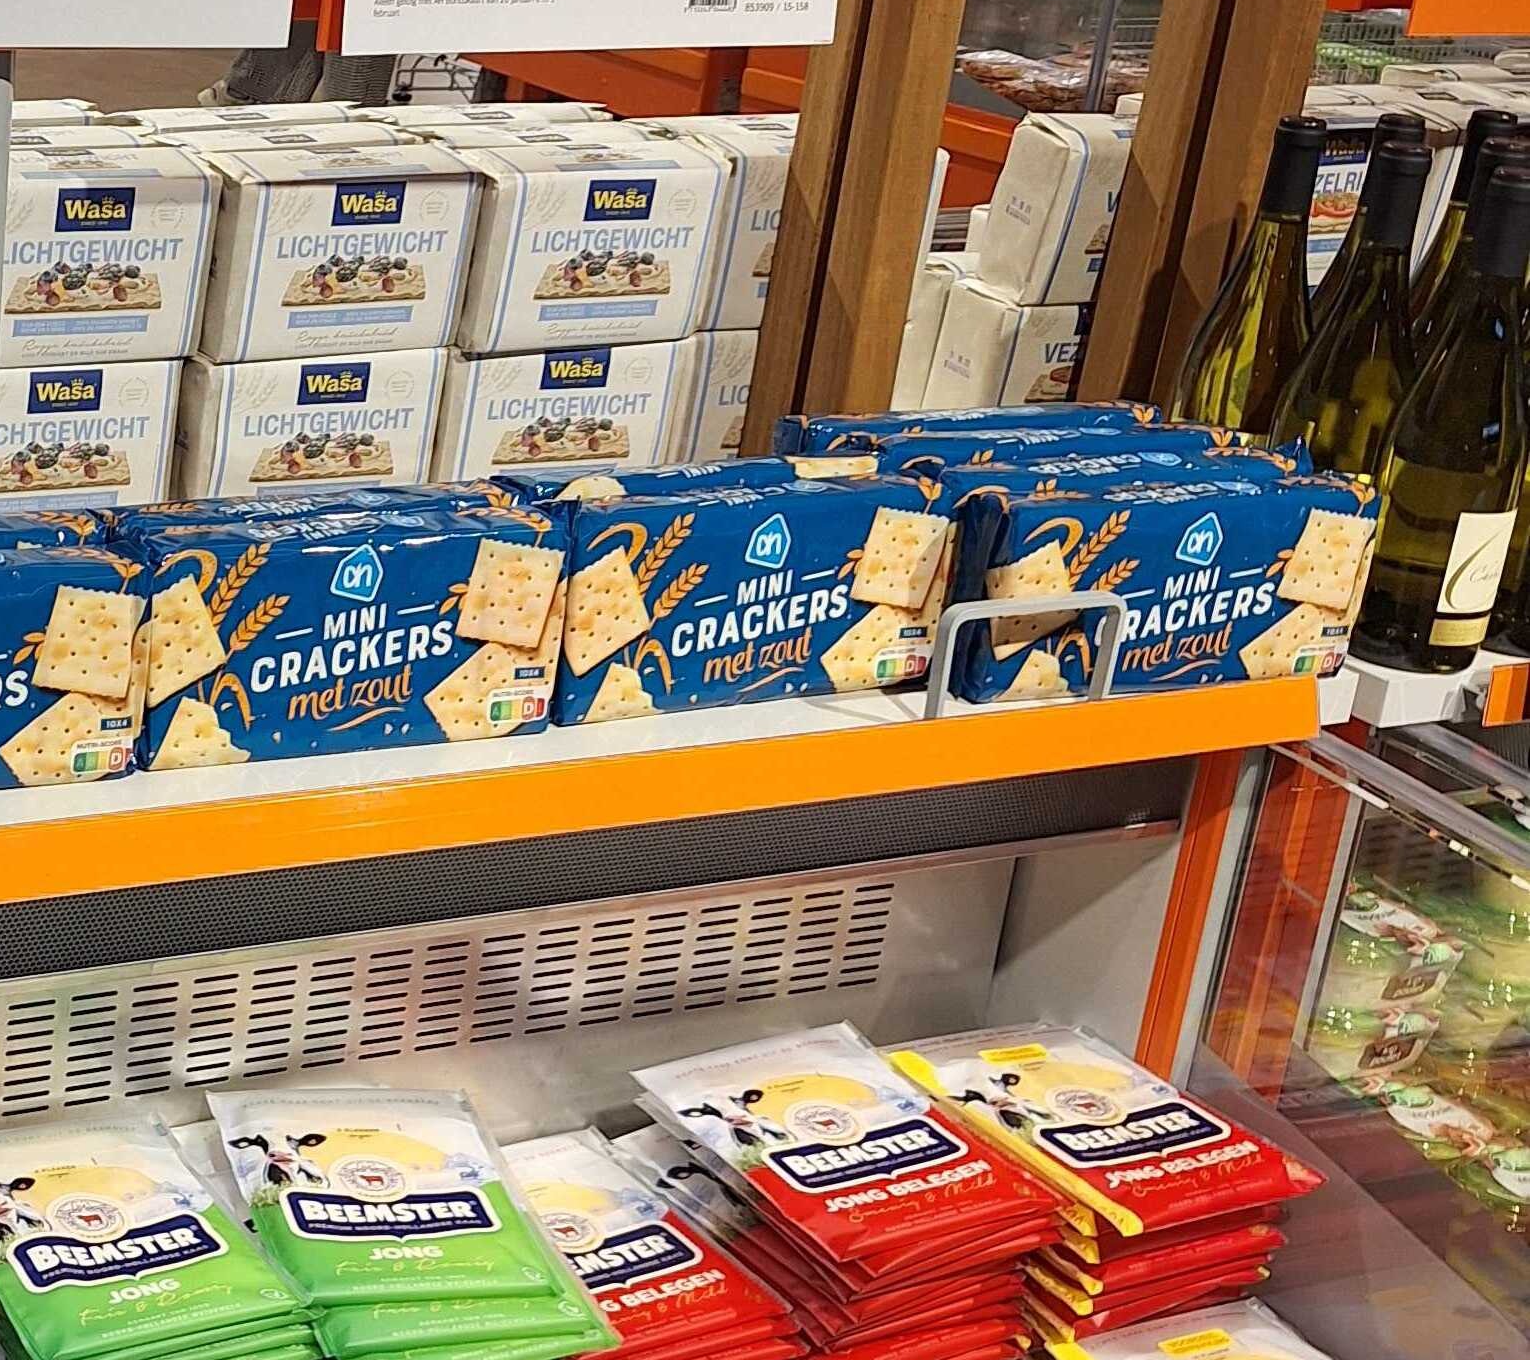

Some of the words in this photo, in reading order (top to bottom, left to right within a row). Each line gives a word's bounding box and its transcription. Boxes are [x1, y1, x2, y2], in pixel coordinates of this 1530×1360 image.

[530, 225, 693, 254] LICHTGEWICHT
[737, 571, 793, 601] MINI
[324, 602, 387, 640] MINI
[672, 583, 849, 657] CRACKERS
[251, 619, 453, 693] CRACKERS
[703, 645, 756, 684] met
[759, 629, 813, 670] zout
[288, 679, 345, 721] met
[351, 662, 413, 708] zout
[790, 1128, 938, 1179] BEEMSTER
[824, 1188, 884, 1215] JONG
[886, 1159, 990, 1199] BELEGEN
[301, 1198, 476, 1229] BEEMSTER
[28, 1227, 200, 1272] BEEMSTER
[368, 1244, 444, 1263] JONG
[107, 1277, 181, 1305] JONG
